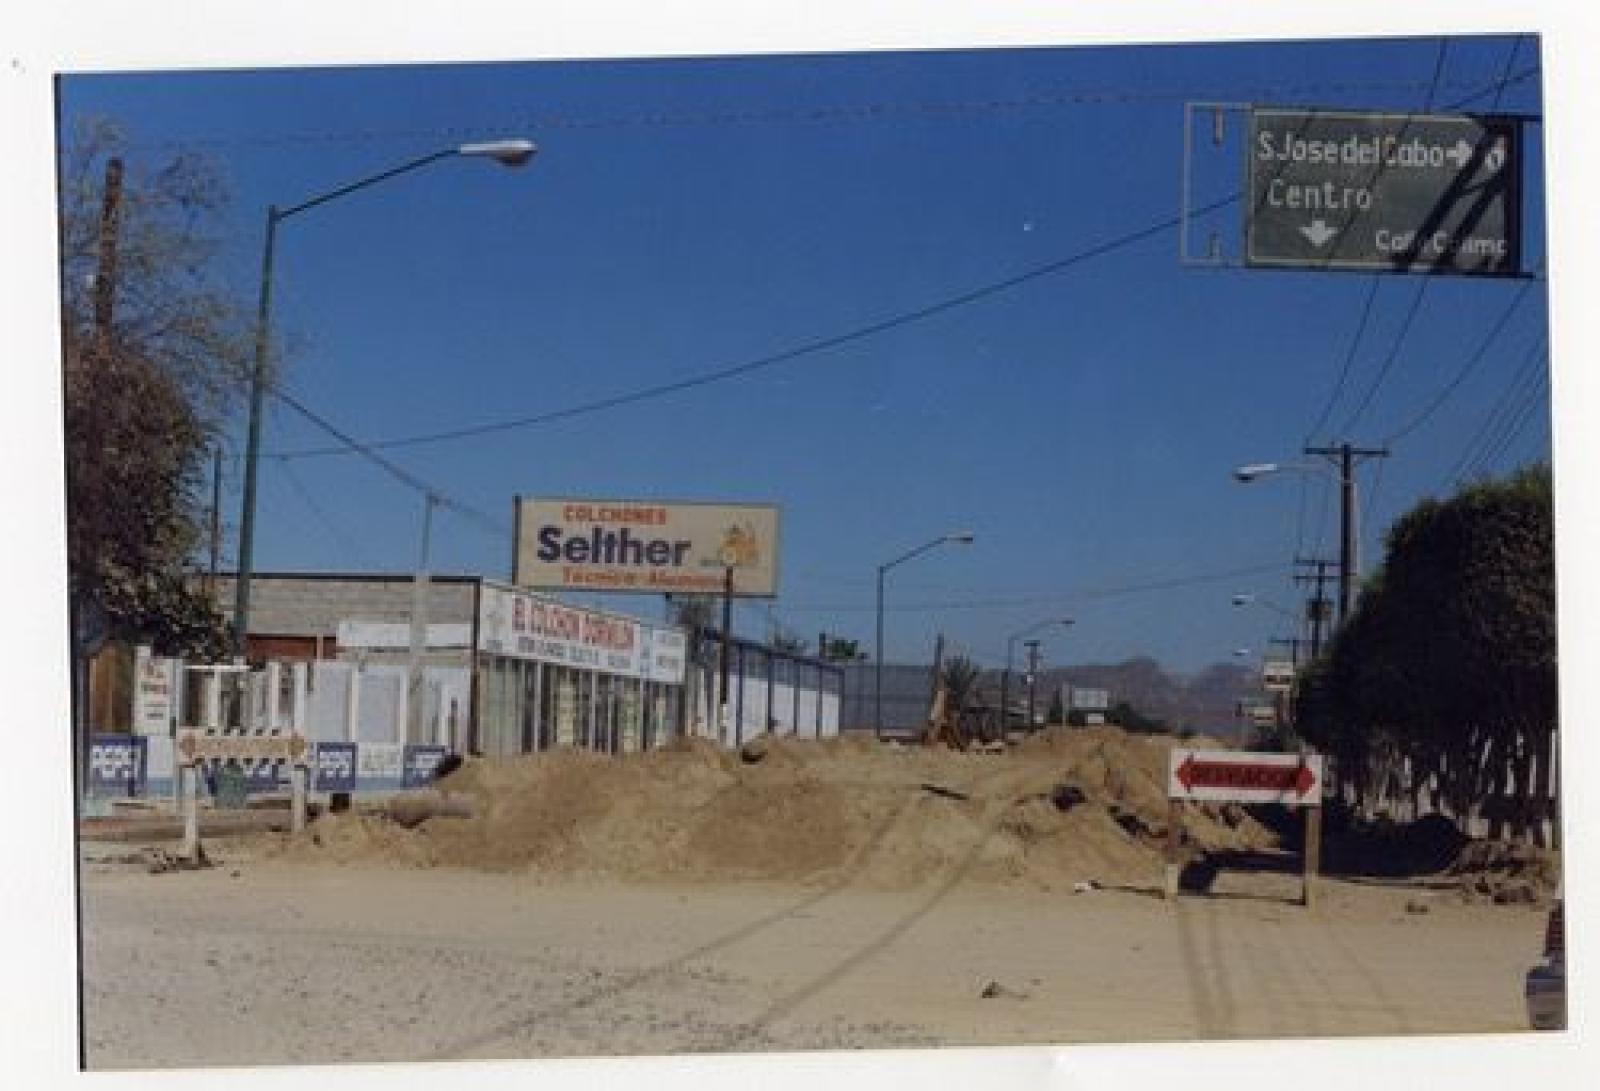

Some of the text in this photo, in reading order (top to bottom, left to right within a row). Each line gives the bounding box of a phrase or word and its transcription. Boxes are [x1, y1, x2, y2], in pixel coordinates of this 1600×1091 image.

[1268, 178, 1372, 210] Centro
[563, 504, 667, 526] COLCHONES
[537, 524, 693, 567] Selther
